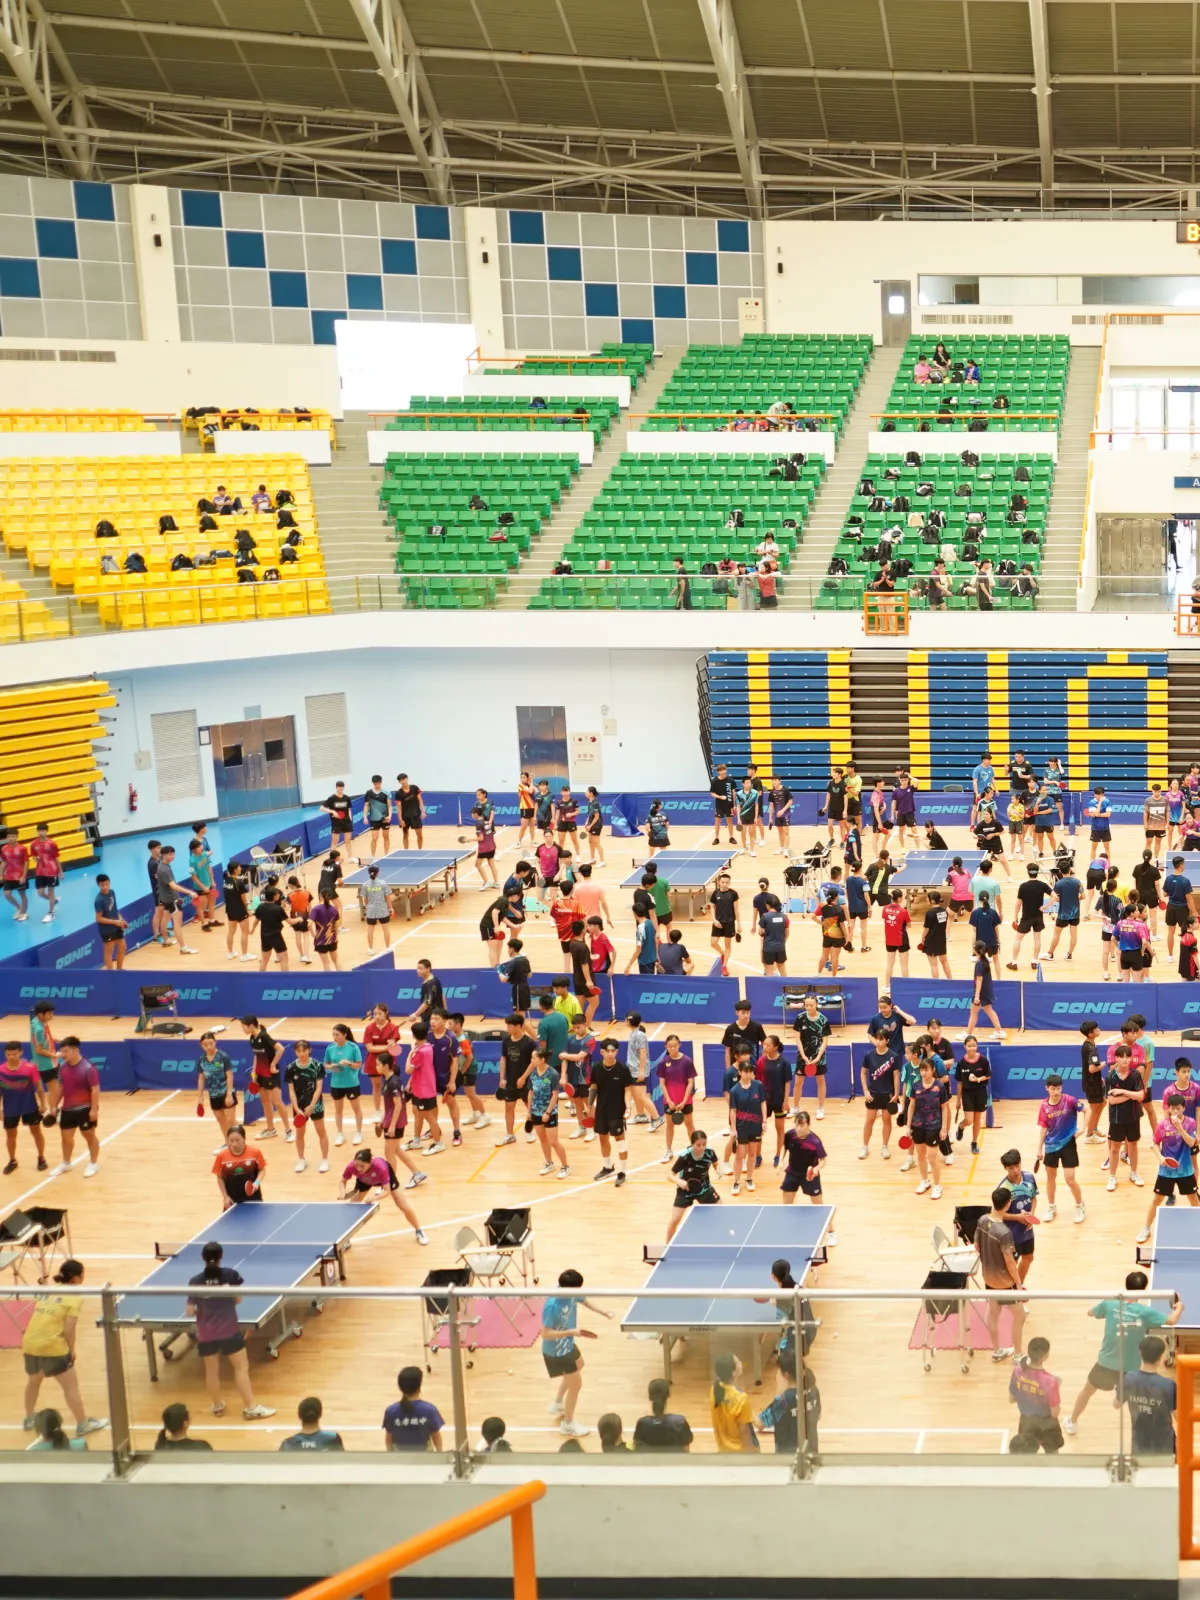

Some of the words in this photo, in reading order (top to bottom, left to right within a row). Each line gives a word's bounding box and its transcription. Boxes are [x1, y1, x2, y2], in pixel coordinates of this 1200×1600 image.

[1193, 478, 1200, 487] A
[920, 805, 970, 814] DONIC
[56, 942, 93, 969] DONIC
[20, 986, 88, 998] DONIC
[176, 988, 213, 1000] NIC
[262, 989, 335, 1001] DONIC
[639, 992, 710, 1005] DONIC
[918, 997, 972, 1009] DONI
[1052, 1002, 1128, 1014] DONIC
[1129, 1395, 1148, 1404] YANG
[1138, 1405, 1152, 1415] TPE
[301, 1442, 316, 1450] TPE
